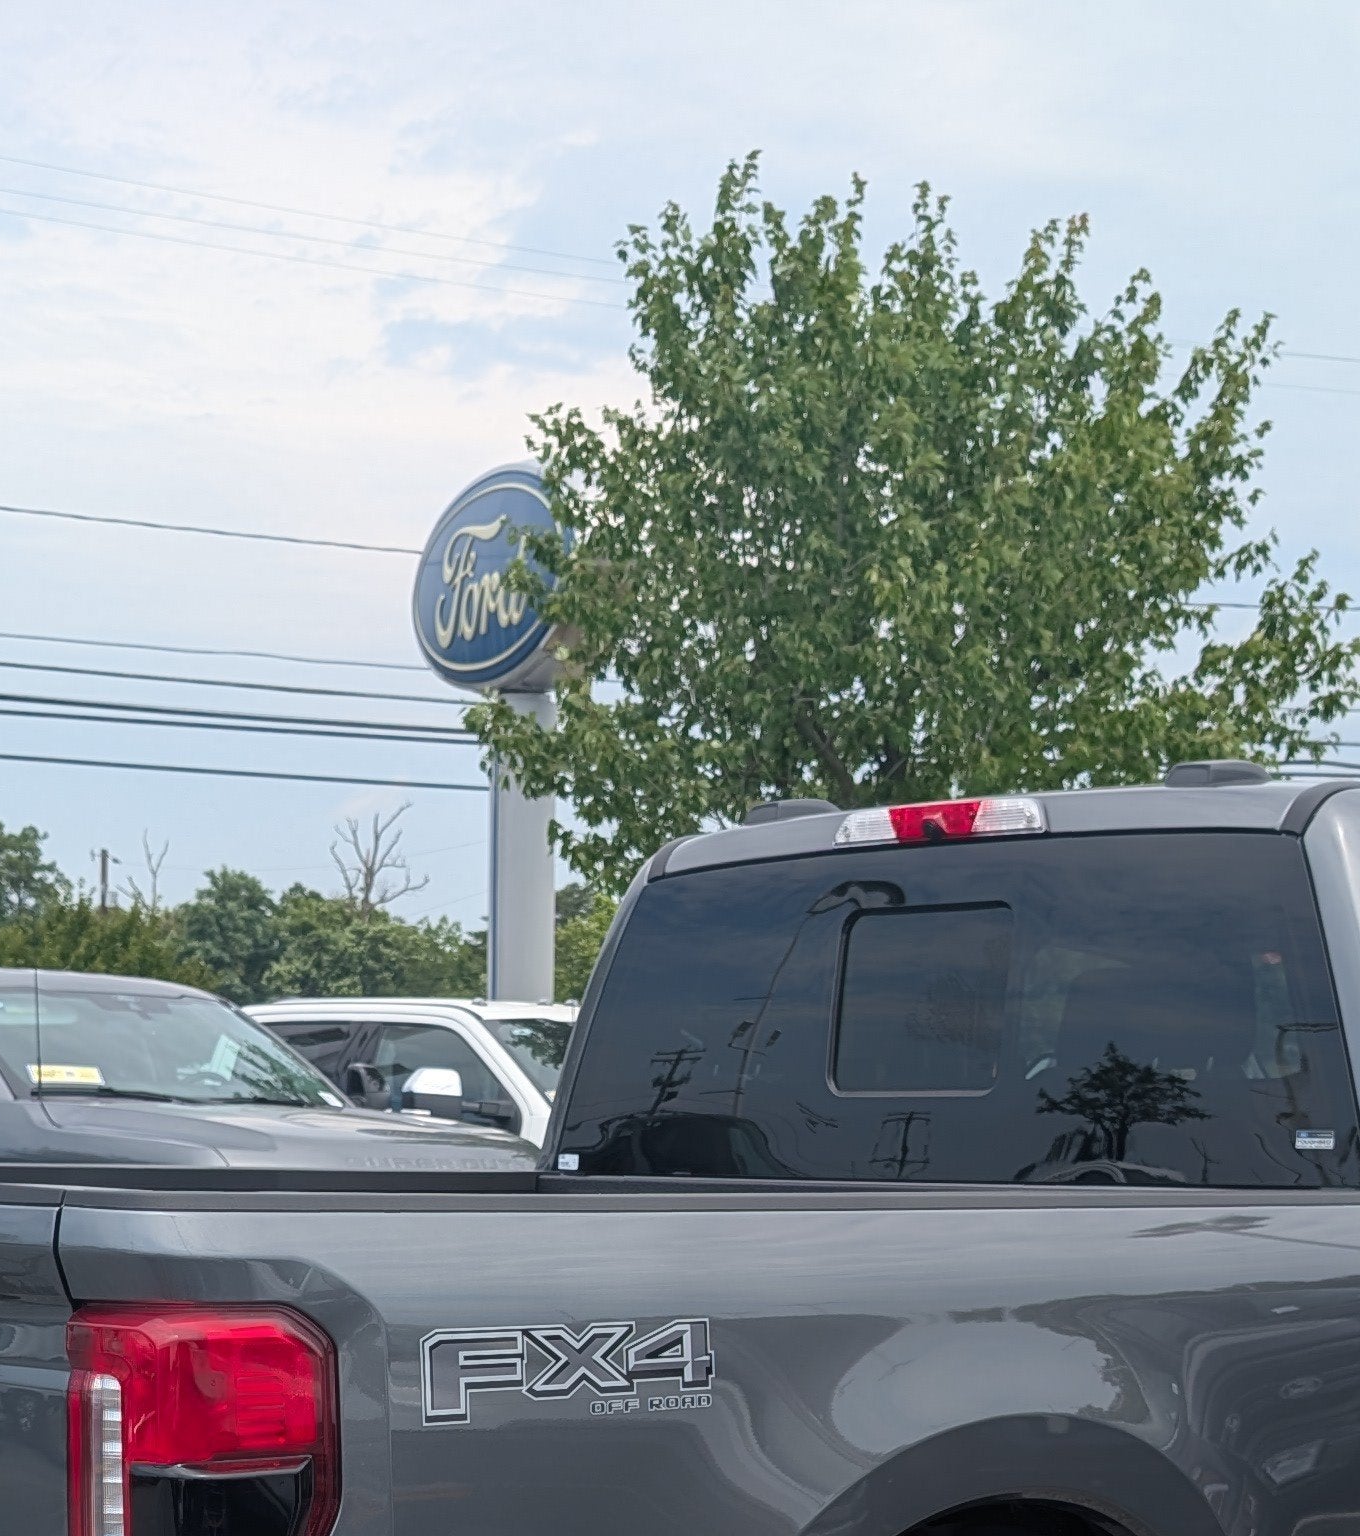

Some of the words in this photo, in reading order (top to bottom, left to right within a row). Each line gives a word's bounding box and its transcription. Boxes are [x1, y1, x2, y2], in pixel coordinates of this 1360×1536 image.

[419, 1318, 715, 1426] FX4
[590, 1398, 640, 1416] OFF
[648, 1394, 712, 1412] ROAD
